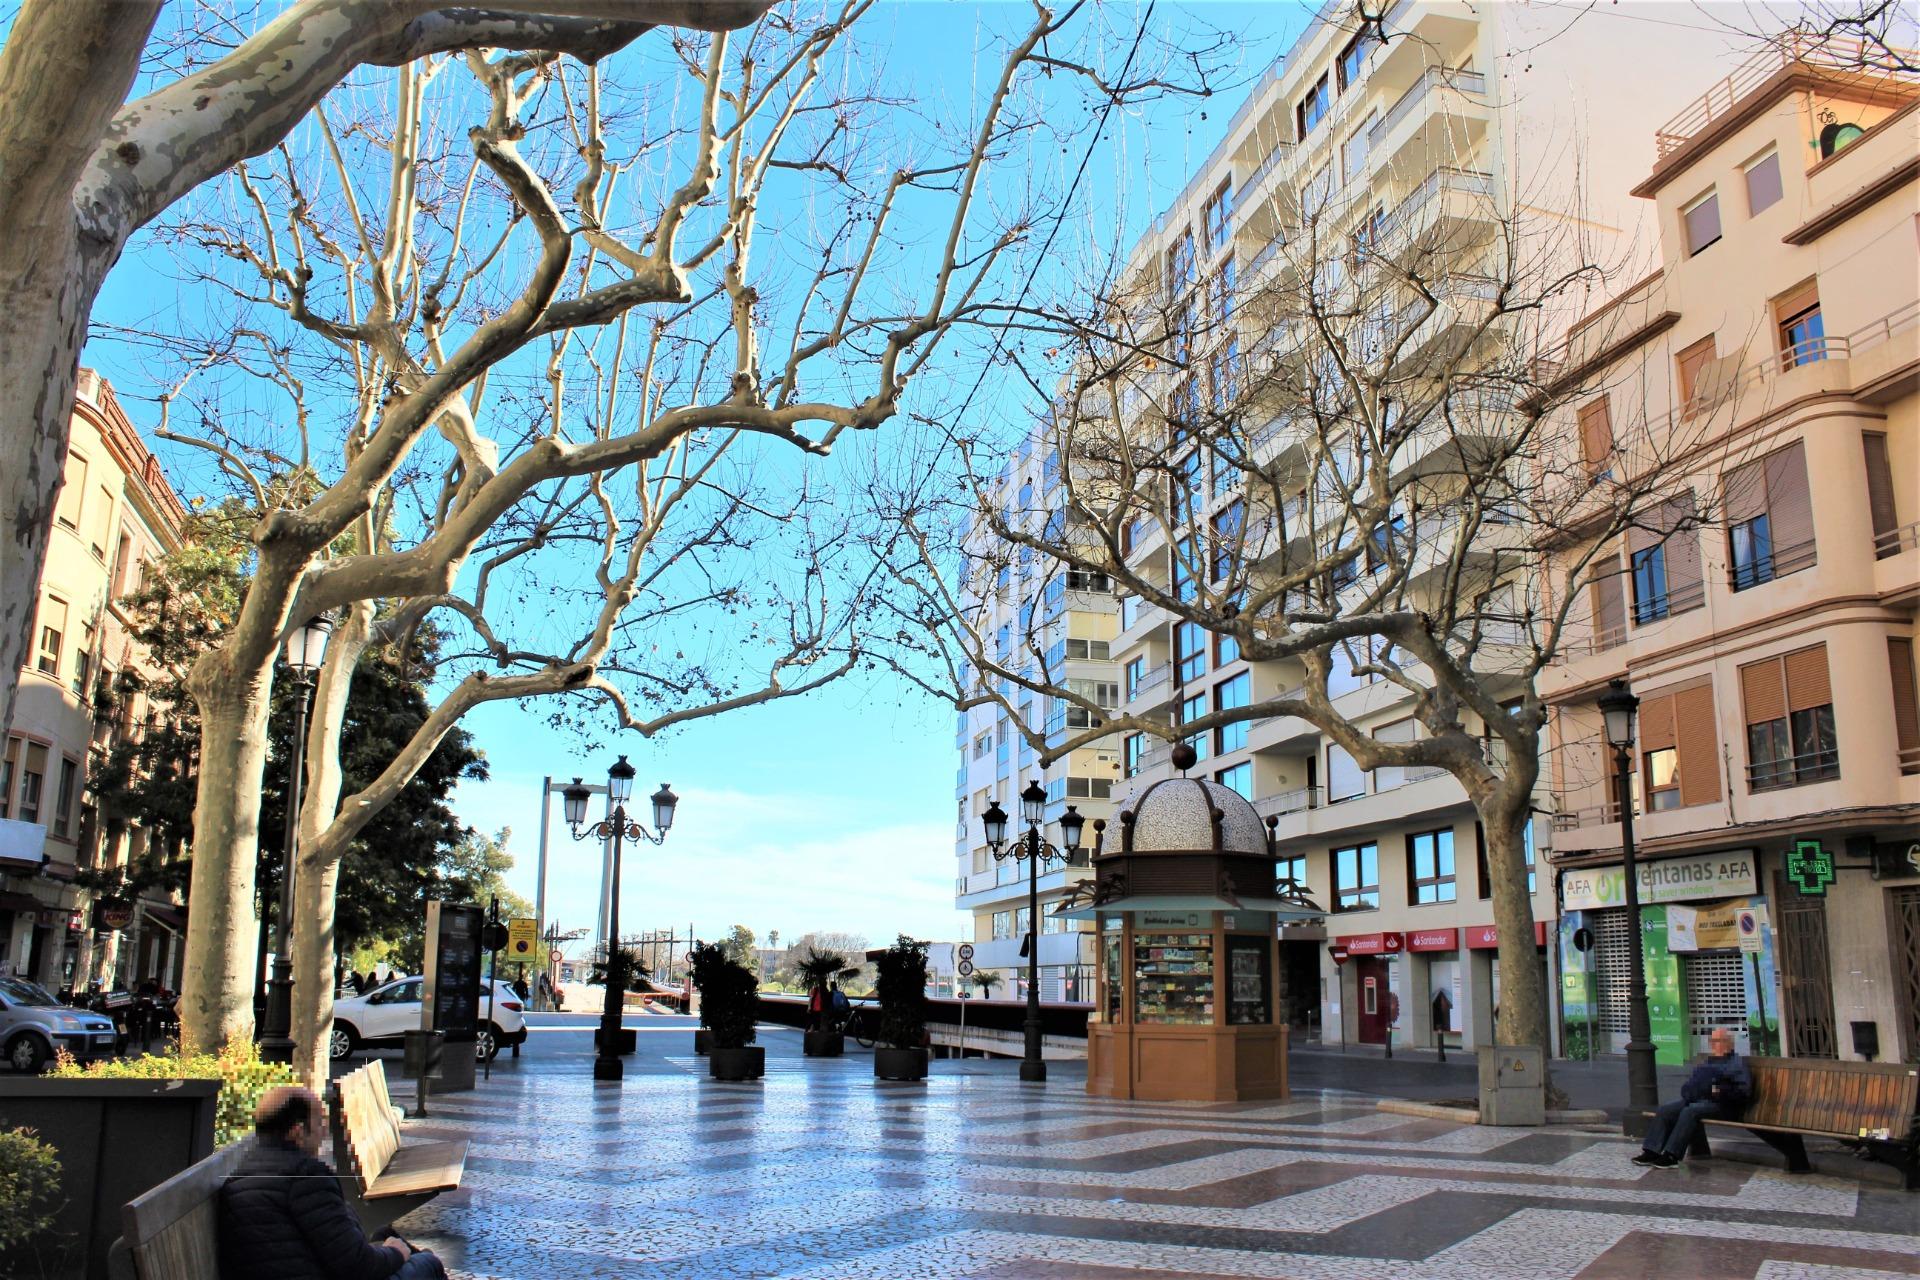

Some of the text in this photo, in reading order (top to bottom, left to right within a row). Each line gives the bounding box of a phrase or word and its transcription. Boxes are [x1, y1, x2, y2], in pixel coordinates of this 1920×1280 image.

[1719, 861, 1750, 880] AFA
[1566, 879, 1591, 895] AFA
[105, 911, 129, 921] KING
[1355, 940, 1378, 949] Santander
[1420, 936, 1447, 946] Santander
